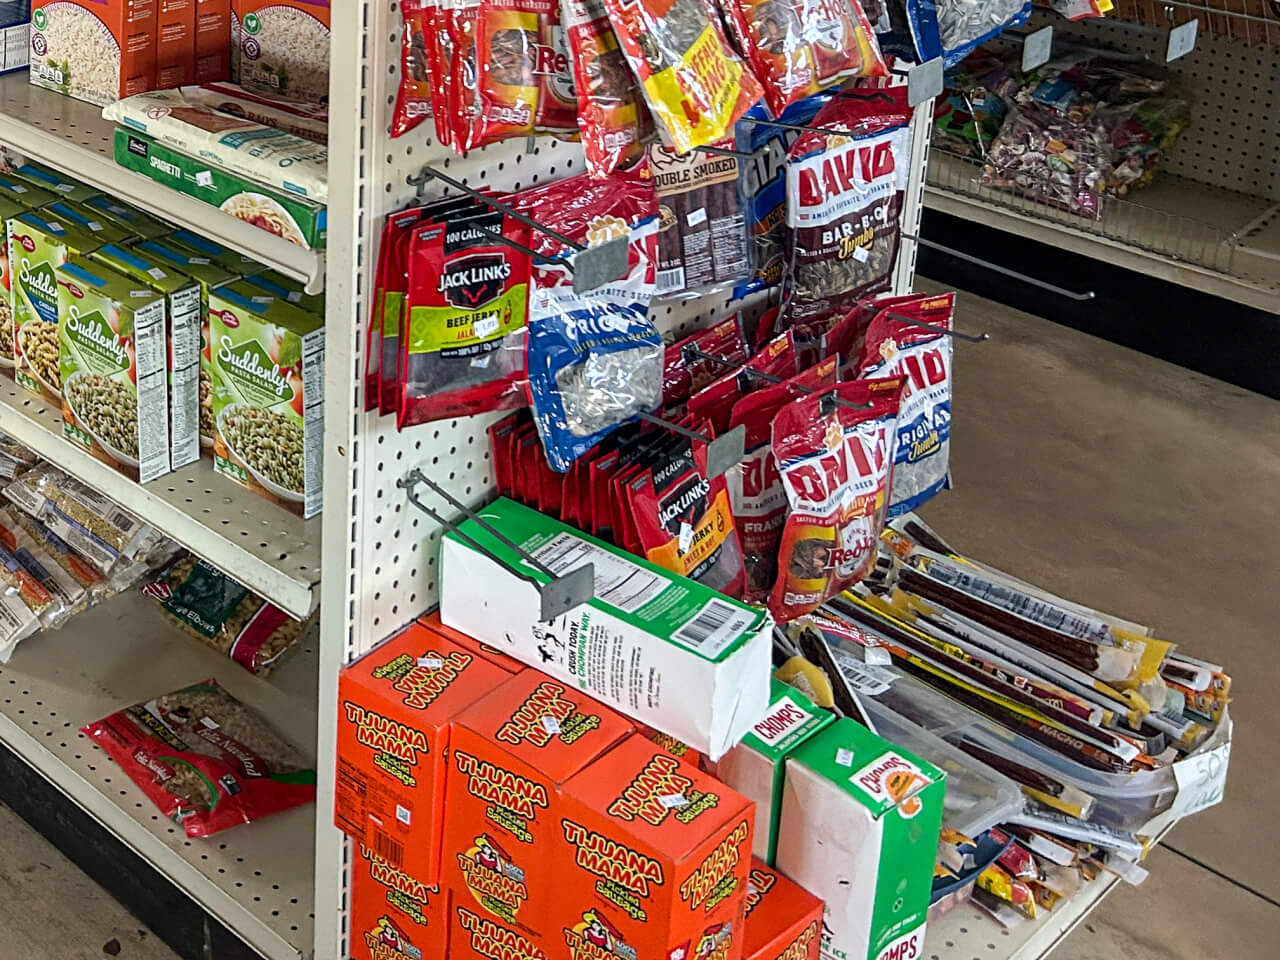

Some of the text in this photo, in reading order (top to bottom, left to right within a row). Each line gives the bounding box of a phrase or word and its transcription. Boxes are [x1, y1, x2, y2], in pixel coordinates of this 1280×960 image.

[150, 156, 181, 178] SPAGHETTI
[693, 157, 737, 178] SMOKED
[800, 140, 895, 207] DAVID
[446, 232, 459, 244] 100
[838, 227, 874, 259] Jumbo
[437, 271, 471, 292] JACK
[67, 305, 129, 364] Suddenly!
[447, 314, 471, 328] BEEF
[472, 308, 502, 324] JERKY
[218, 335, 292, 394] Suddenly!
[231, 367, 272, 390] PASTA SALAD
[658, 479, 710, 530] JACK LINK'S
[187, 610, 217, 634] Elbows
[569, 649, 578, 675] CRUSH
[579, 635, 590, 678] CHOMPIAN
[403, 652, 473, 710] TIJUANA
[344, 700, 429, 753] TIJUANA
[496, 680, 565, 745] TIJUANA
[560, 715, 601, 745] Sausage
[754, 703, 804, 740] CHOMPS
[357, 725, 417, 765] MAMA
[1040, 723, 1084, 750] NACHO
[222, 739, 262, 778] Navidad
[373, 754, 417, 788] Sausage
[382, 752, 411, 775] Pickled
[454, 750, 549, 807] TIJUANA
[607, 753, 680, 821] TIJUANA
[469, 777, 536, 820] MAMA
[495, 806, 528, 830] Pickled
[675, 792, 719, 824] Sausage
[486, 806, 534, 844] Sausage
[562, 819, 664, 885] TIJUANA
[680, 819, 749, 901] TIJUANA
[370, 861, 428, 905] MAMA
[457, 853, 528, 900] TIJUANA
[469, 873, 519, 908] MAMA
[576, 847, 649, 897] MAMA
[691, 849, 738, 910] MAMA
[595, 879, 648, 922] Sausage
[605, 879, 641, 906] Pickled
